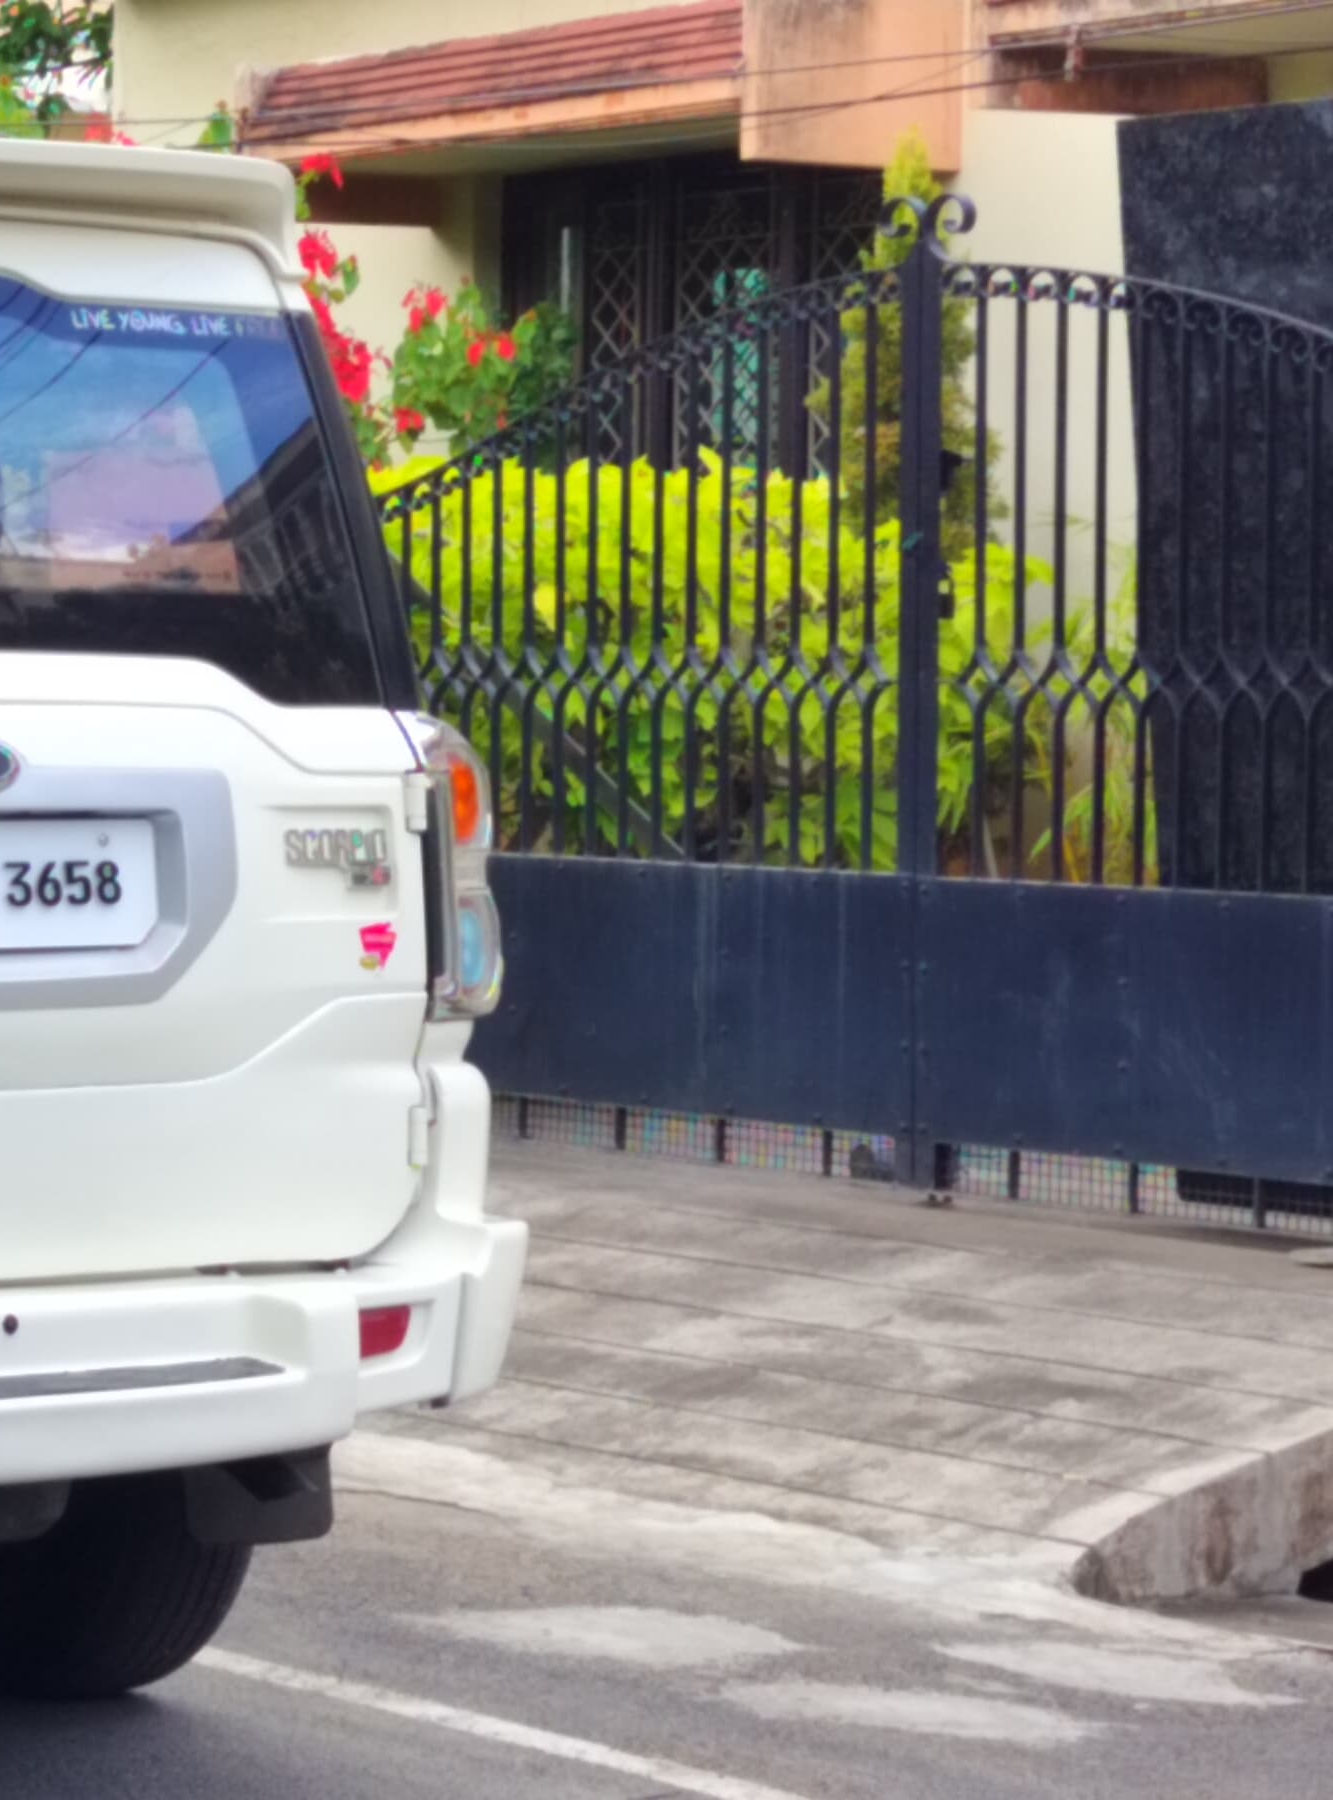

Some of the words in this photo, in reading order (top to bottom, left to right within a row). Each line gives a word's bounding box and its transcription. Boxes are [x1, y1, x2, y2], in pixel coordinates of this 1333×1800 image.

[71, 308, 115, 330] LIVE
[191, 314, 230, 336] LIVE
[3, 860, 123, 908] 3658
